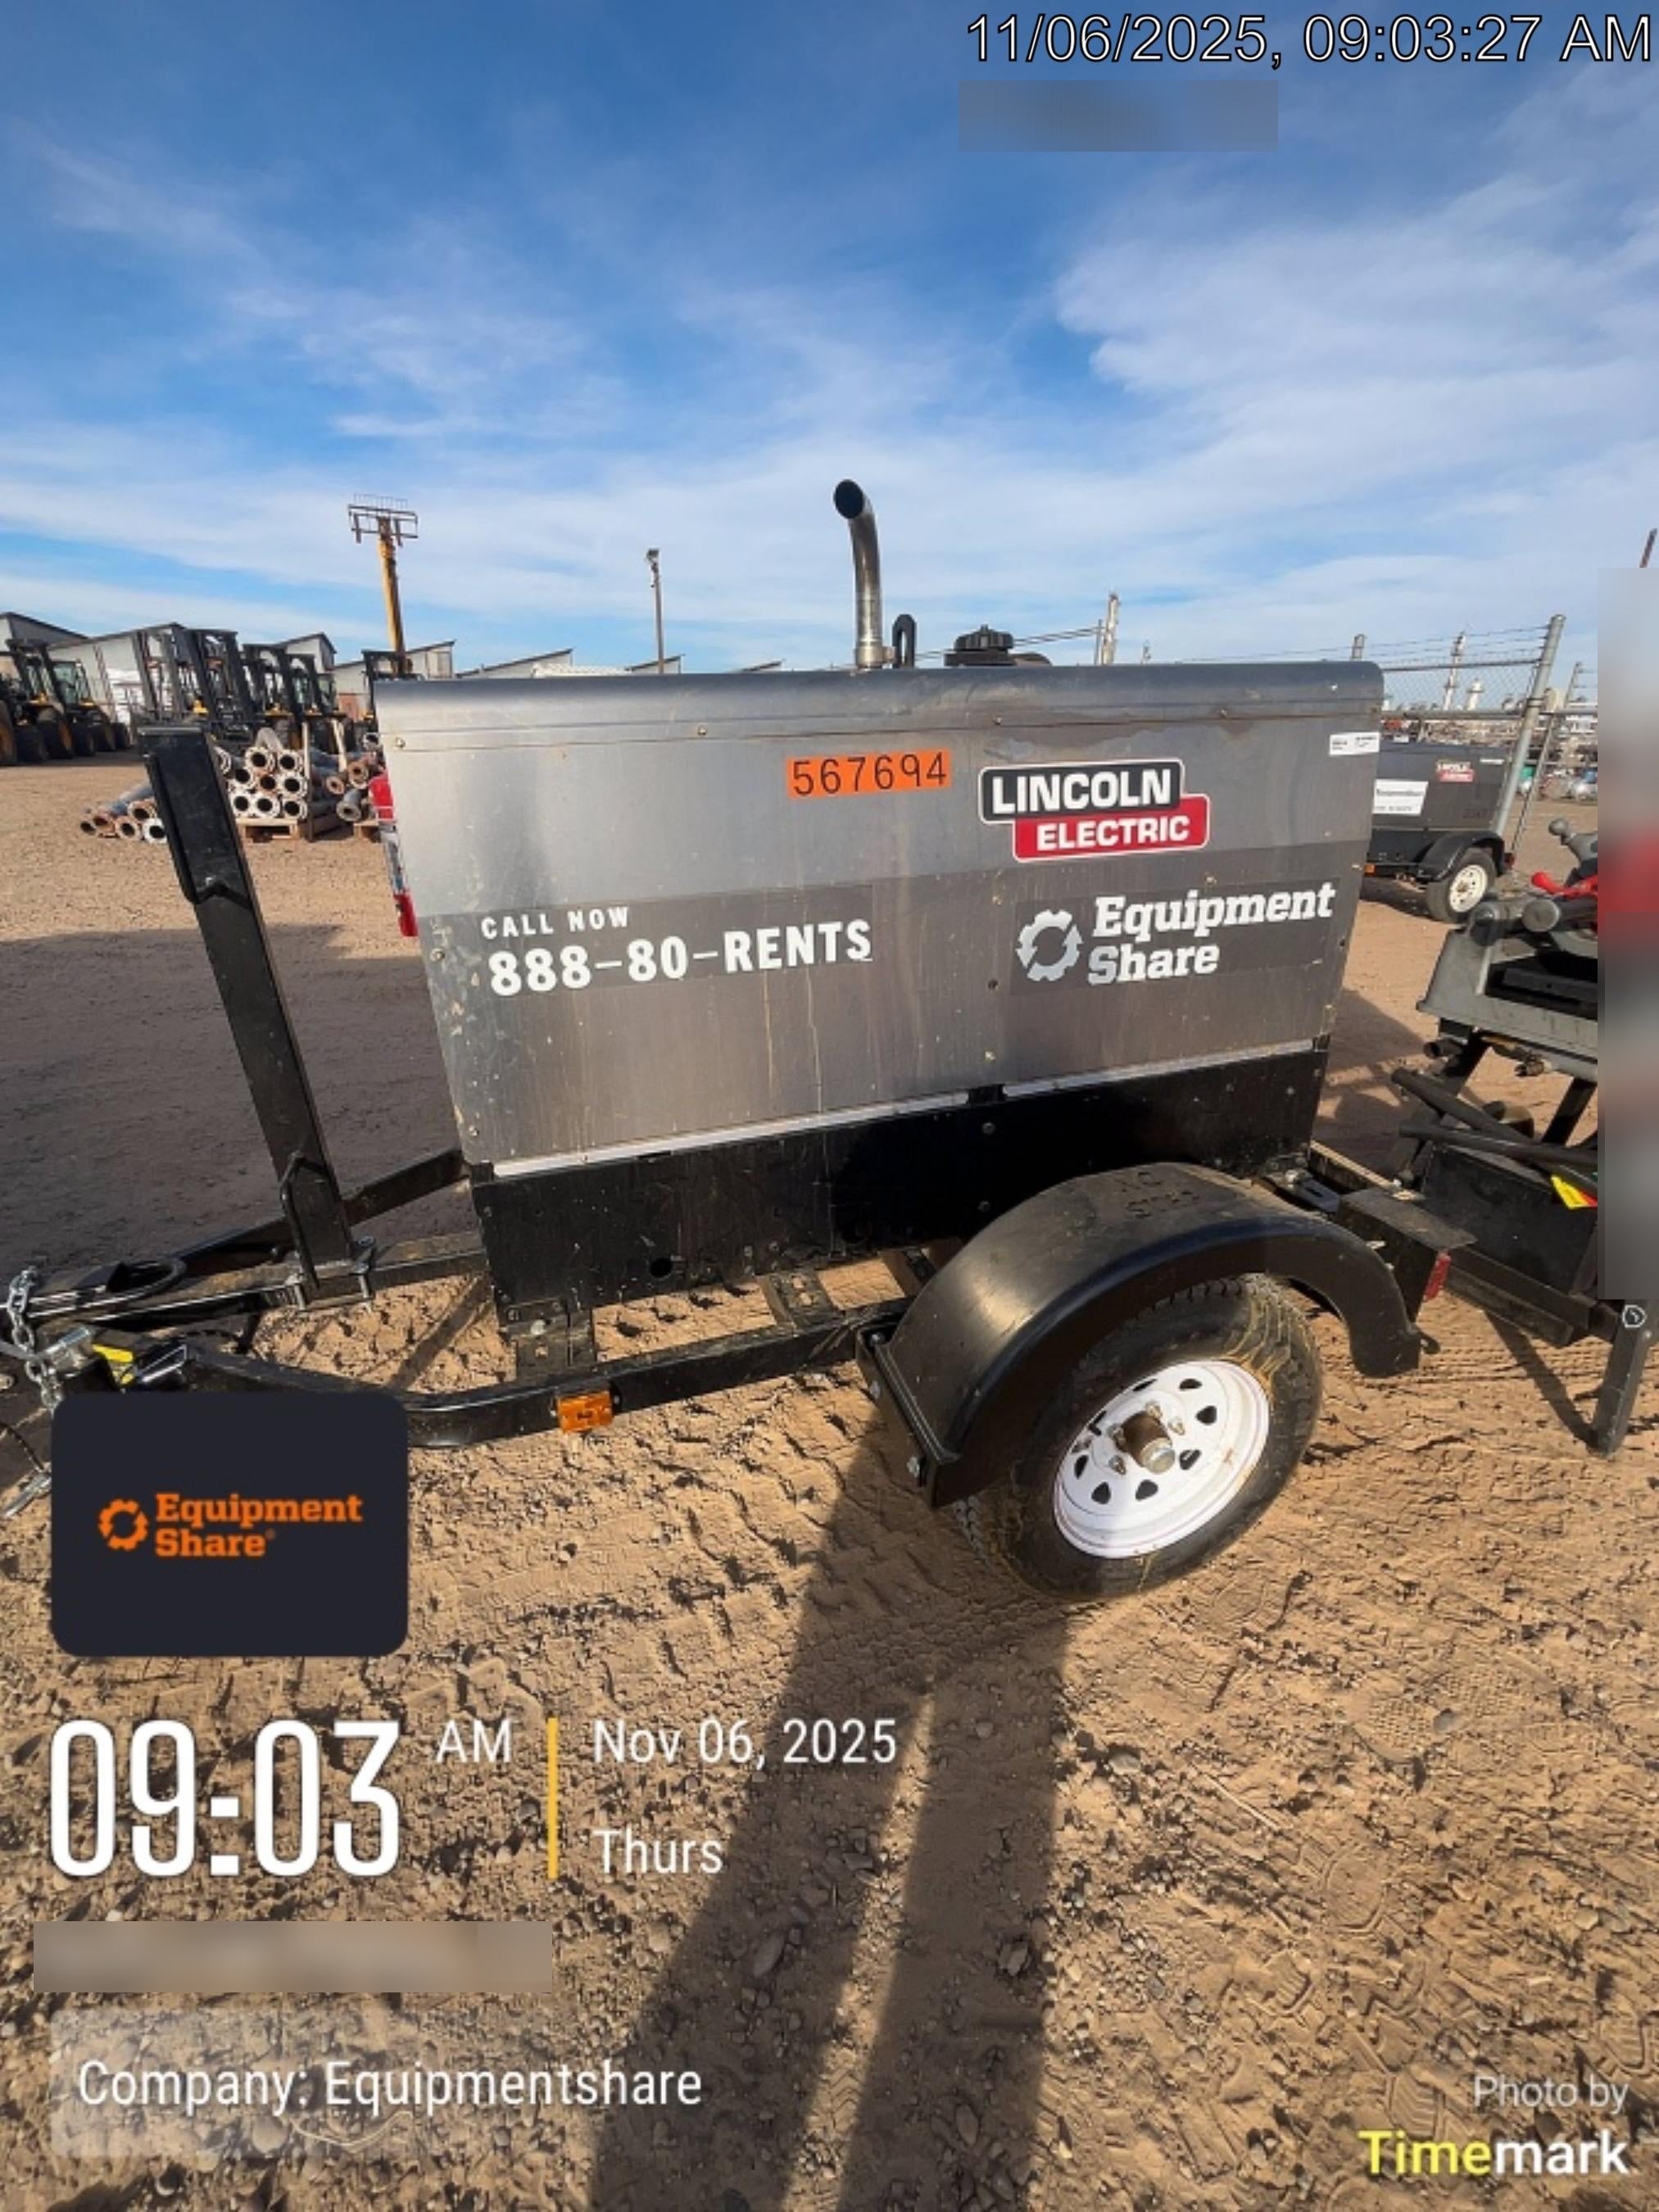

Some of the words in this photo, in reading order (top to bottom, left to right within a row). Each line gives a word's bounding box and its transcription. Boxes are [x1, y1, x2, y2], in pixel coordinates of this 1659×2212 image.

[793, 752, 946, 796] 567694
[991, 768, 1172, 814] LINCOLN
[1036, 815, 1190, 851] ELECTRIC
[481, 913, 555, 940] CALL
[567, 906, 630, 932] NOW
[1092, 882, 1337, 942] Equipment
[488, 918, 873, 997] 888-80-RENTS
[1087, 944, 1220, 985] Share
